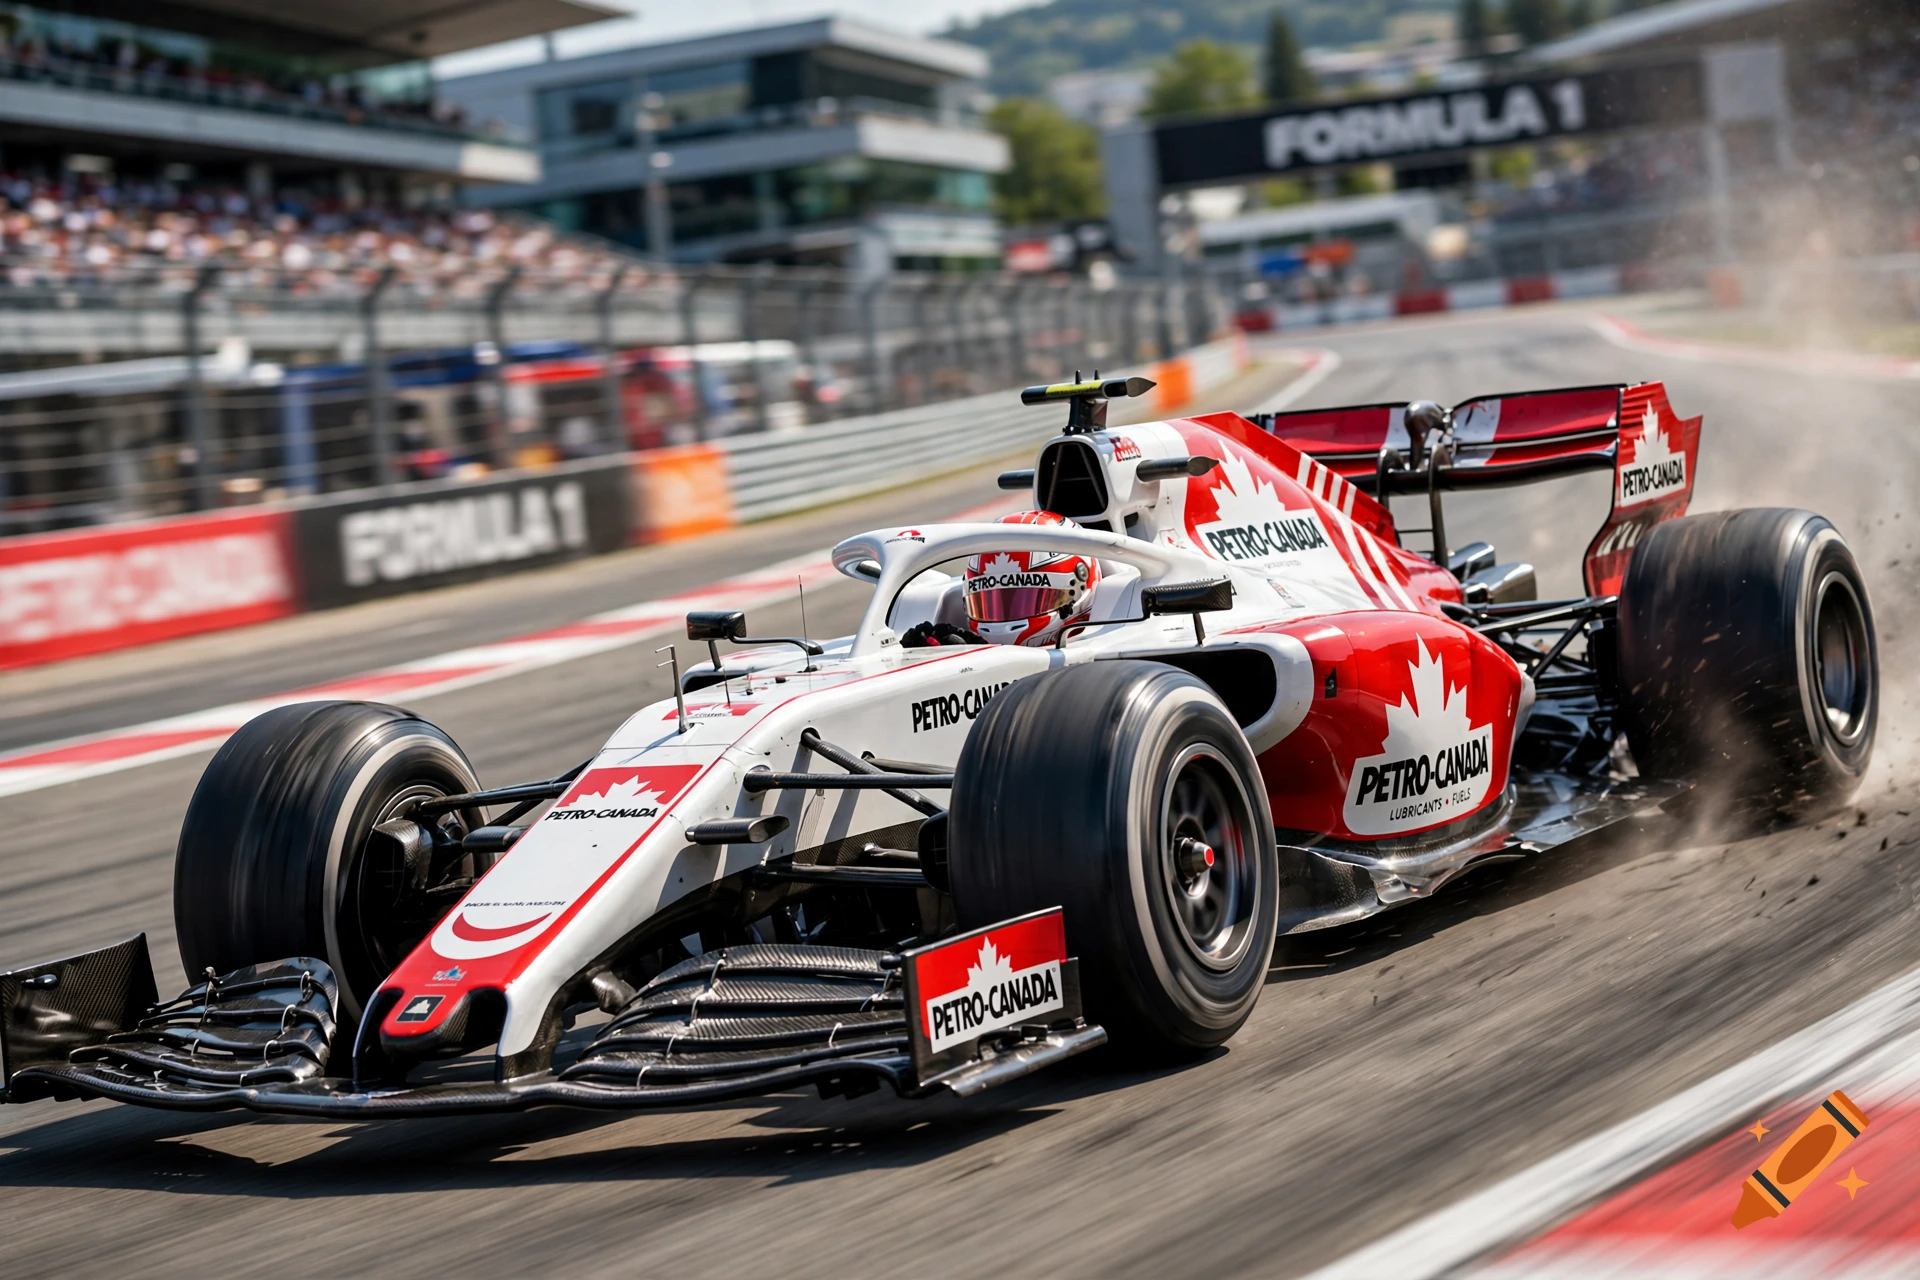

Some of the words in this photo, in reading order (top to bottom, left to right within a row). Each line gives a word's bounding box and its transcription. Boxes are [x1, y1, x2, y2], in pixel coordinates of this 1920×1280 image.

[1264, 86, 1546, 166] FORMULA
[1553, 80, 1585, 129] 1
[1623, 457, 1684, 498] PETRO-CANADA
[340, 486, 556, 586] FORMULA
[552, 482, 586, 548] 1
[1205, 516, 1328, 561] PETRO-CANADA
[968, 573, 1052, 592] PETRO-CANADA
[1355, 735, 1489, 806] PETRO-CANADA
[544, 807, 659, 821] PETRO-CANADA
[1389, 797, 1443, 821] LUBRICANTS
[1451, 787, 1472, 806] FUELS
[932, 968, 1059, 1040] PETRO-CANADA
